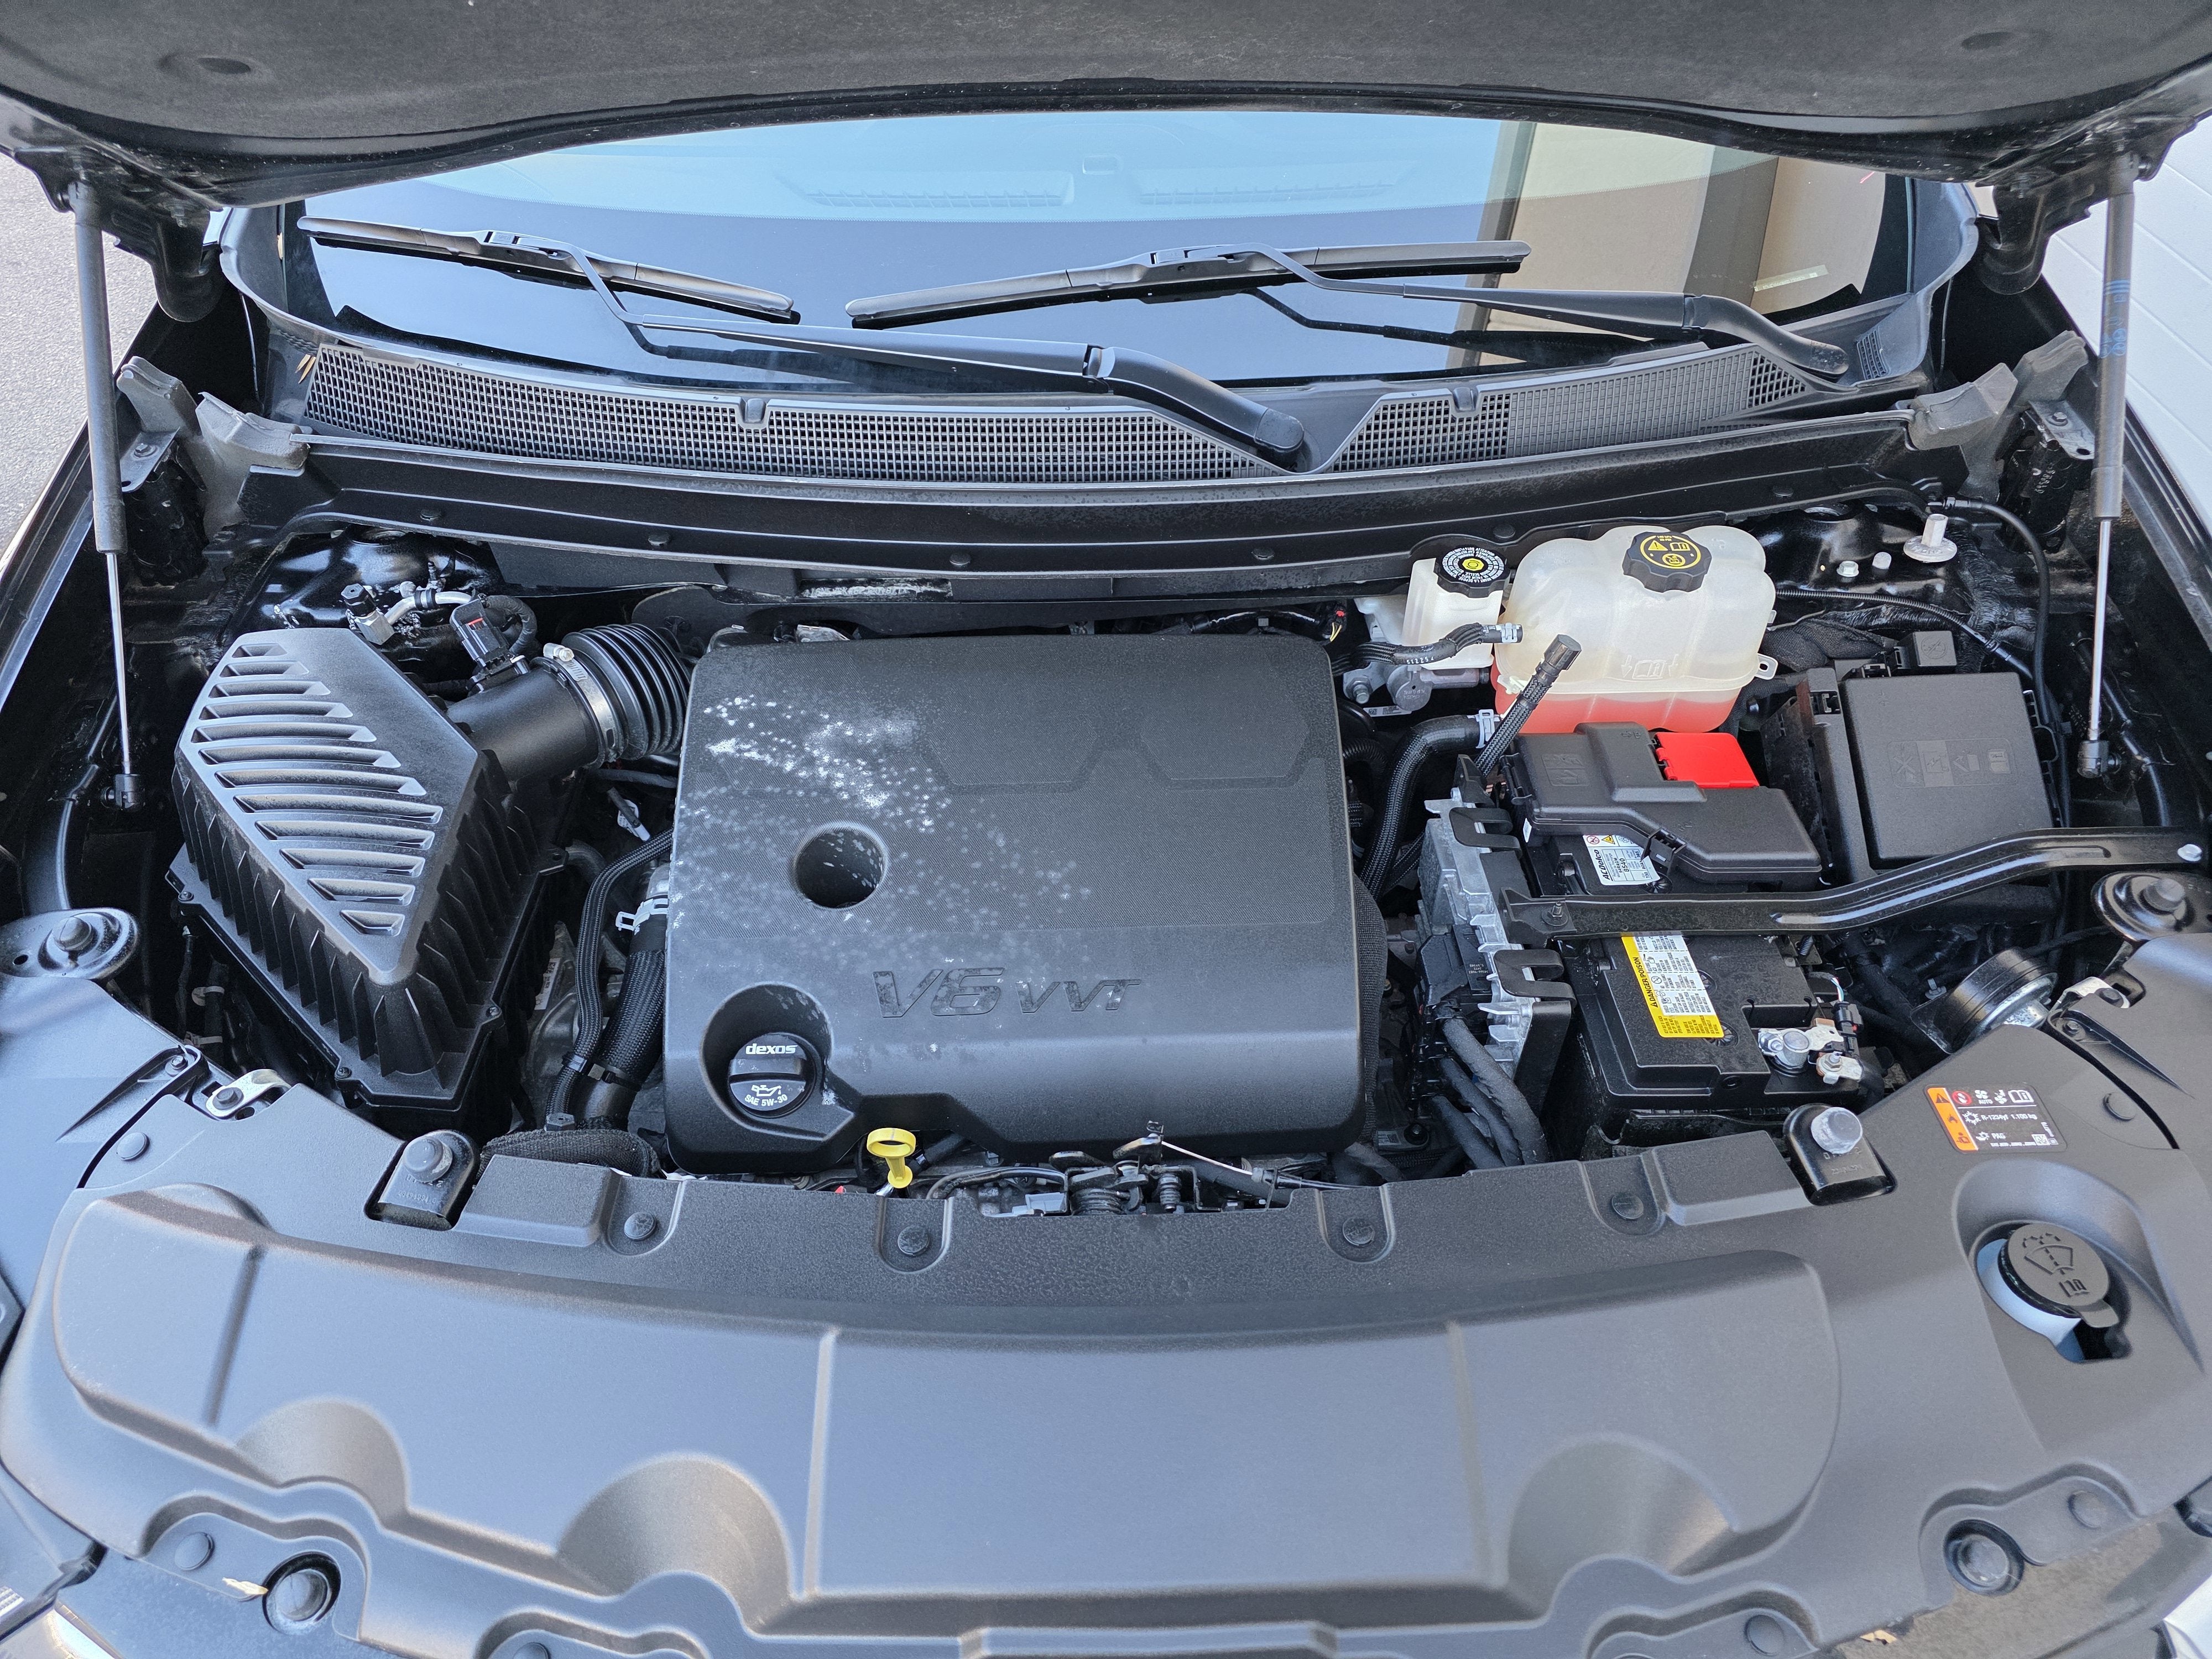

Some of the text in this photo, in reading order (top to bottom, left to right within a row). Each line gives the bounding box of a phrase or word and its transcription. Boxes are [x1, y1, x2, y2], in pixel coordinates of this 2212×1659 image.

[1594, 849, 1611, 880] ACDelco
[1619, 858, 1629, 872] 8540
[872, 967, 1142, 1018] V6 VVT
[745, 1043, 798, 1055] dexos
[744, 1094, 788, 1107] SAE 5W-30
